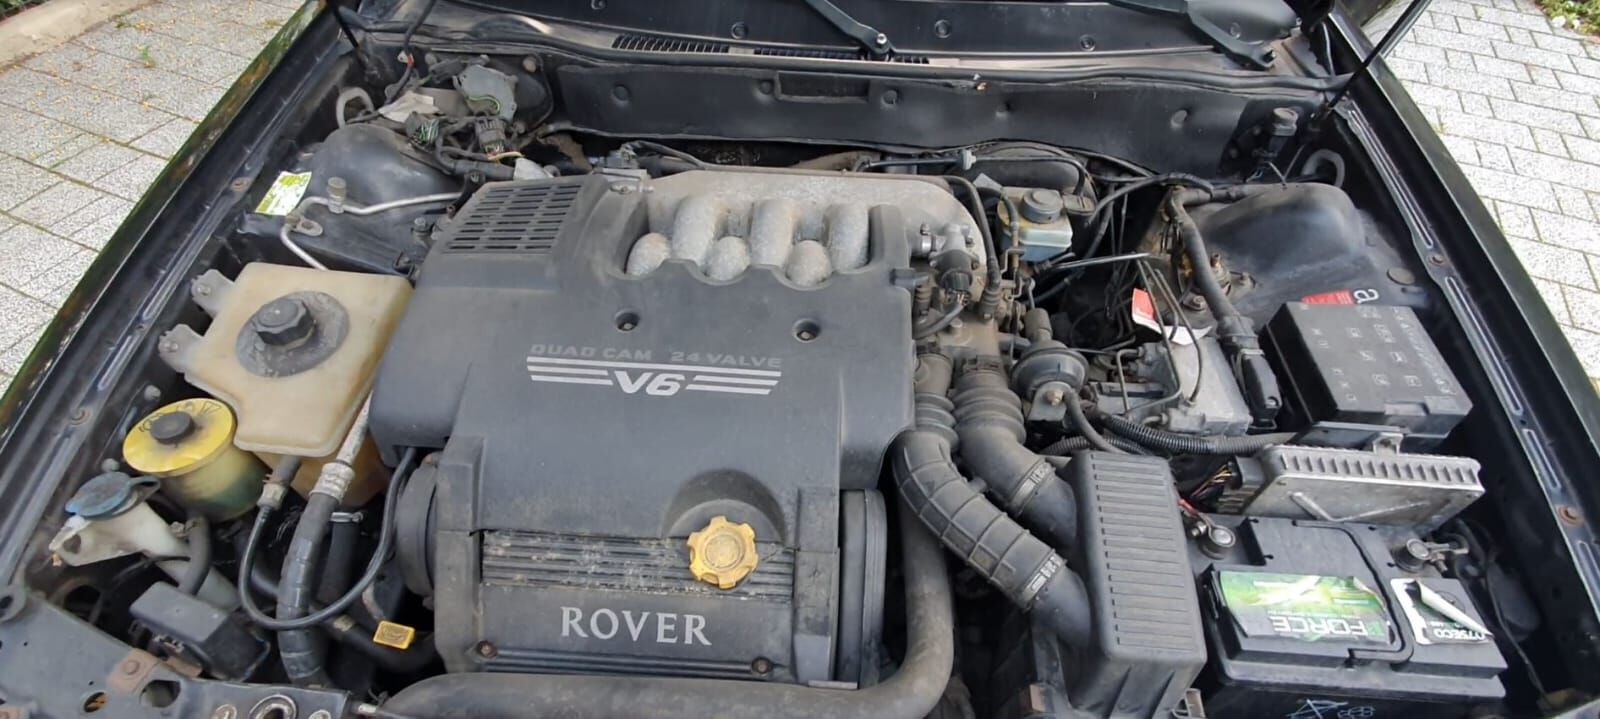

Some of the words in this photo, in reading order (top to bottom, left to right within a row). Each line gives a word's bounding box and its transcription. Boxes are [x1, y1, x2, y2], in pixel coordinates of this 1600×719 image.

[530, 344, 597, 358] QUAD
[602, 347, 653, 361] CAM
[671, 351, 700, 362] 24
[706, 353, 781, 368] VALVE
[614, 370, 685, 396] V6
[560, 606, 712, 646] ROVER
